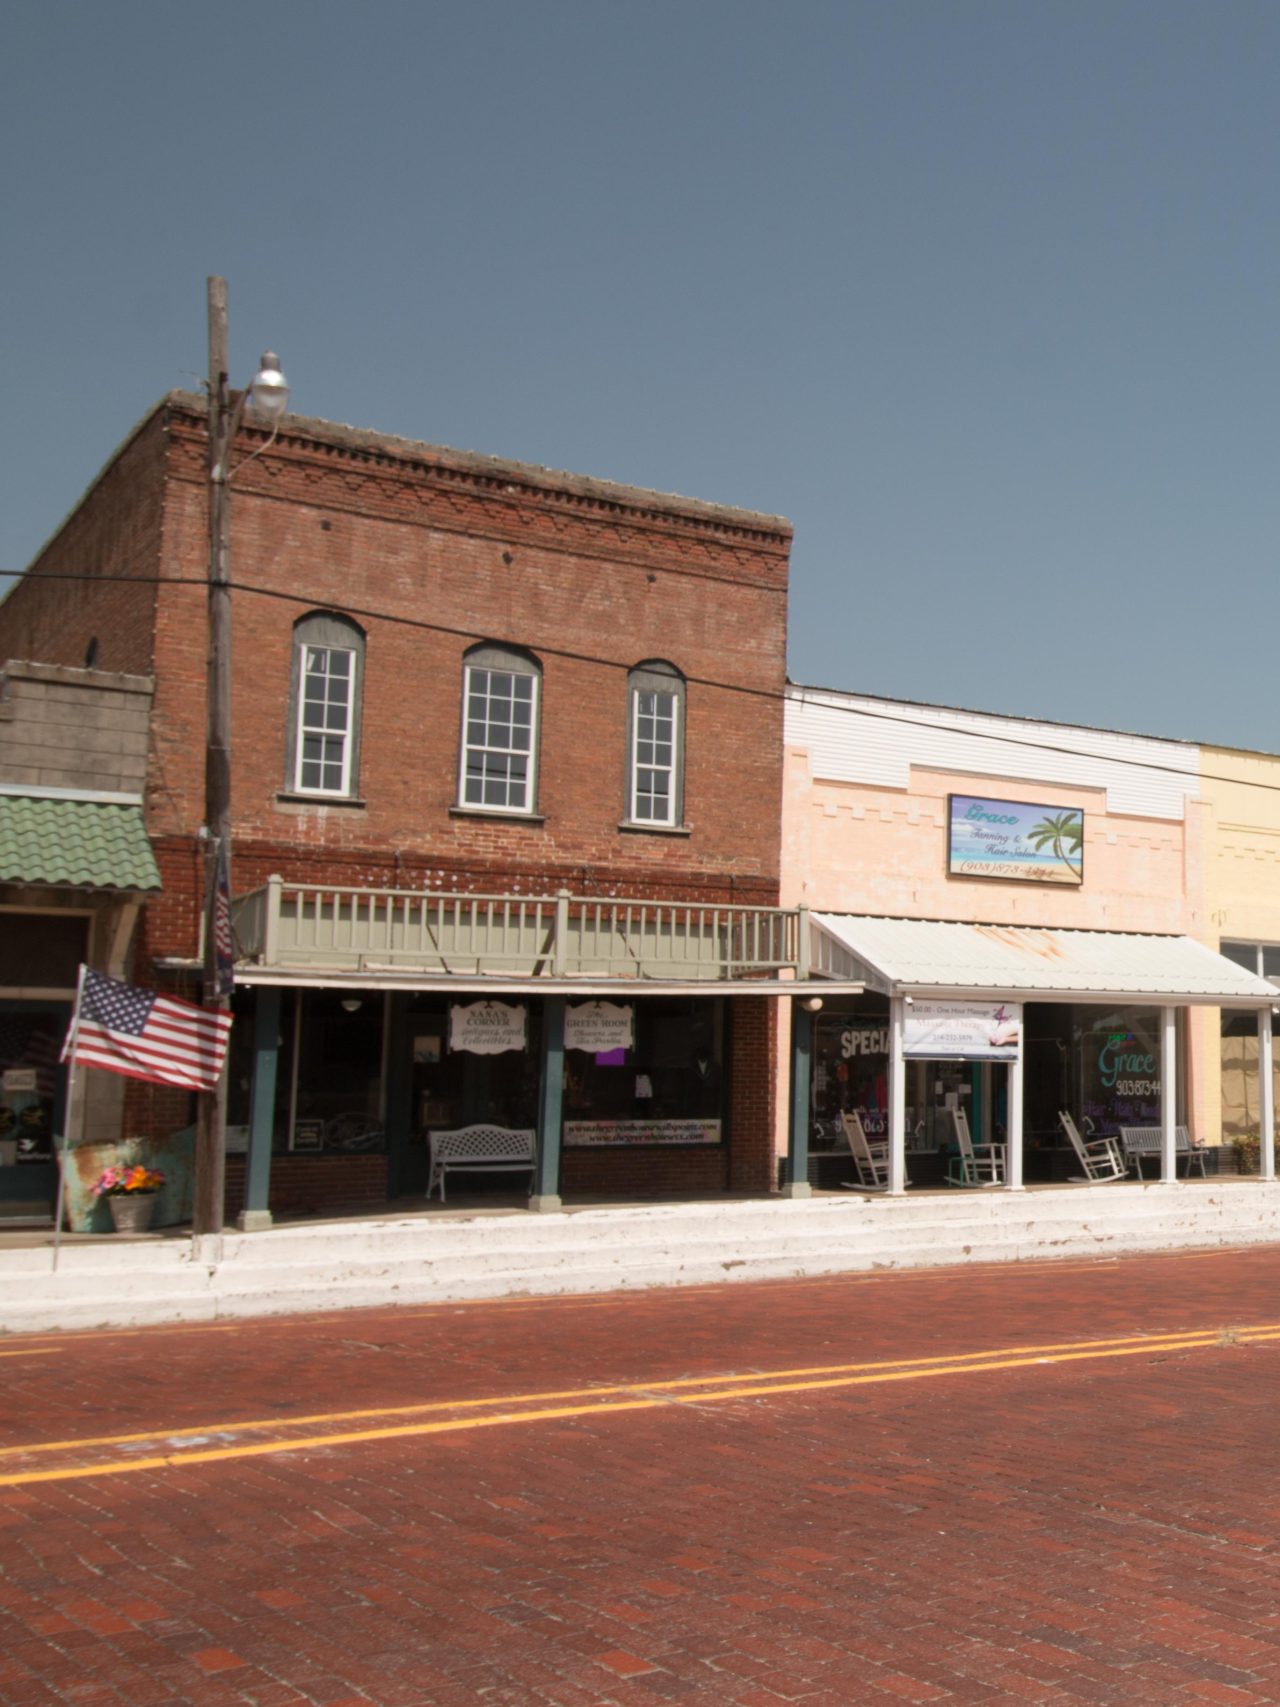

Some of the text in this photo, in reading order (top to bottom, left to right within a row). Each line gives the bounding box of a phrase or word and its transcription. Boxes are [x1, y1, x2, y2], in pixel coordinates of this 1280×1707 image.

[964, 803, 1018, 826] Grace
[970, 828, 1008, 845] Tanning
[984, 844, 1008, 857] Hair
[469, 1010, 508, 1018] NANA'S
[937, 1006, 950, 1014] One
[951, 1006, 966, 1014] Hour
[467, 1018, 510, 1027] CORNER
[566, 1019, 598, 1028] GREEN
[1098, 1038, 1156, 1087] Grace
